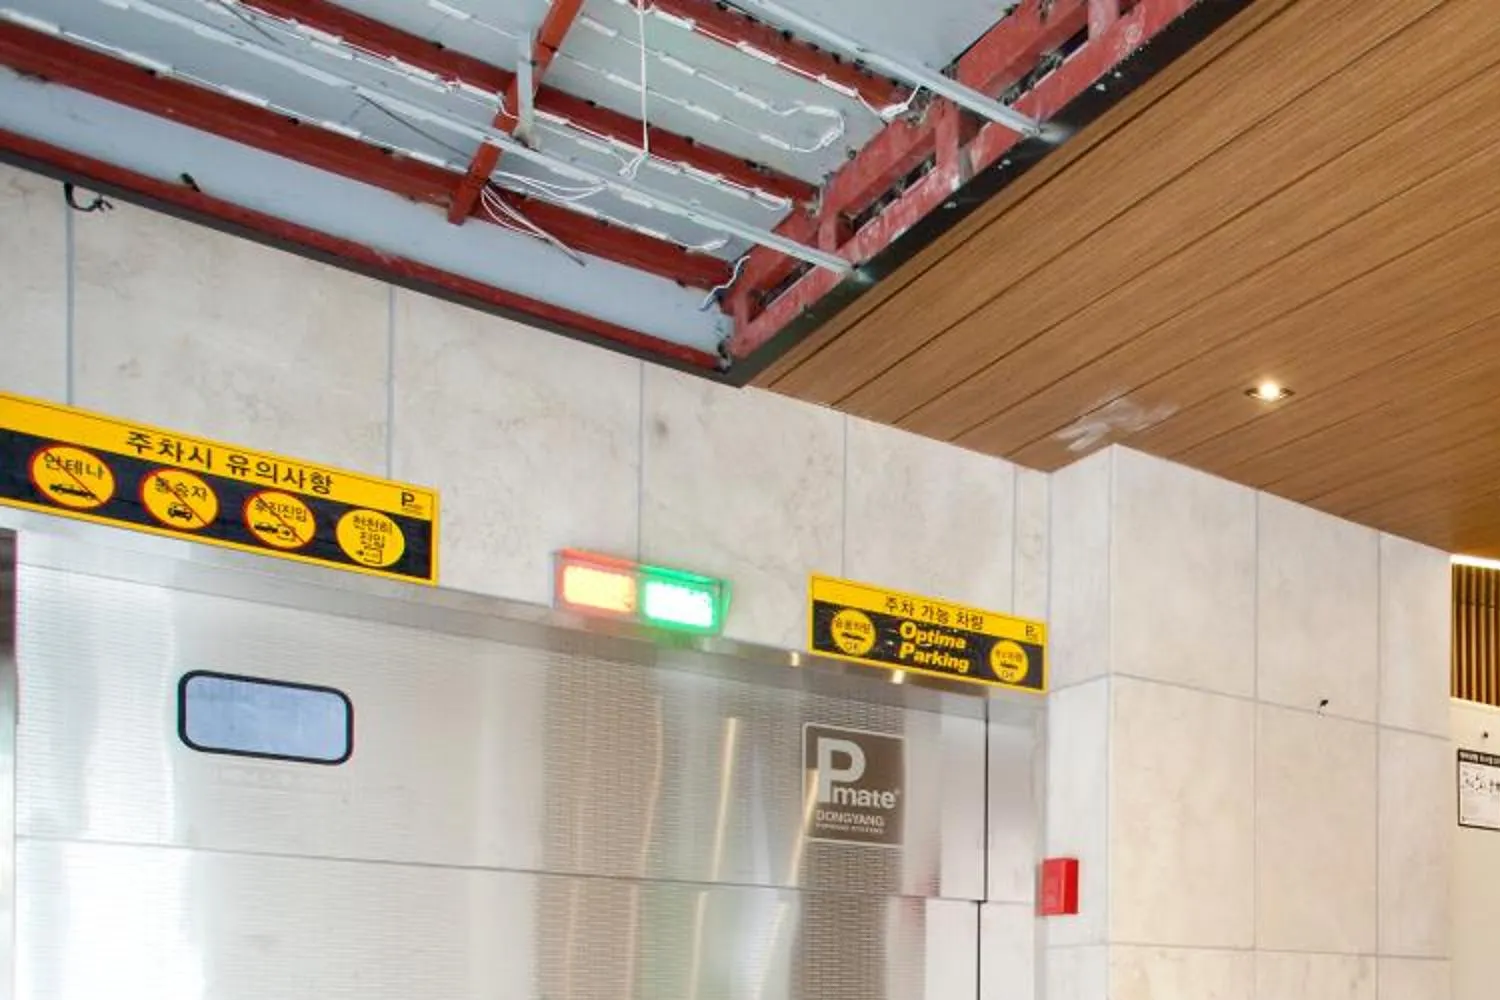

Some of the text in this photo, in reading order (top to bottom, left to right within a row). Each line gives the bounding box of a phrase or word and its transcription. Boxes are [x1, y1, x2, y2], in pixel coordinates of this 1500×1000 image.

[126, 431, 334, 495] 주차시 유의사항
[899, 643, 970, 673] Parking
